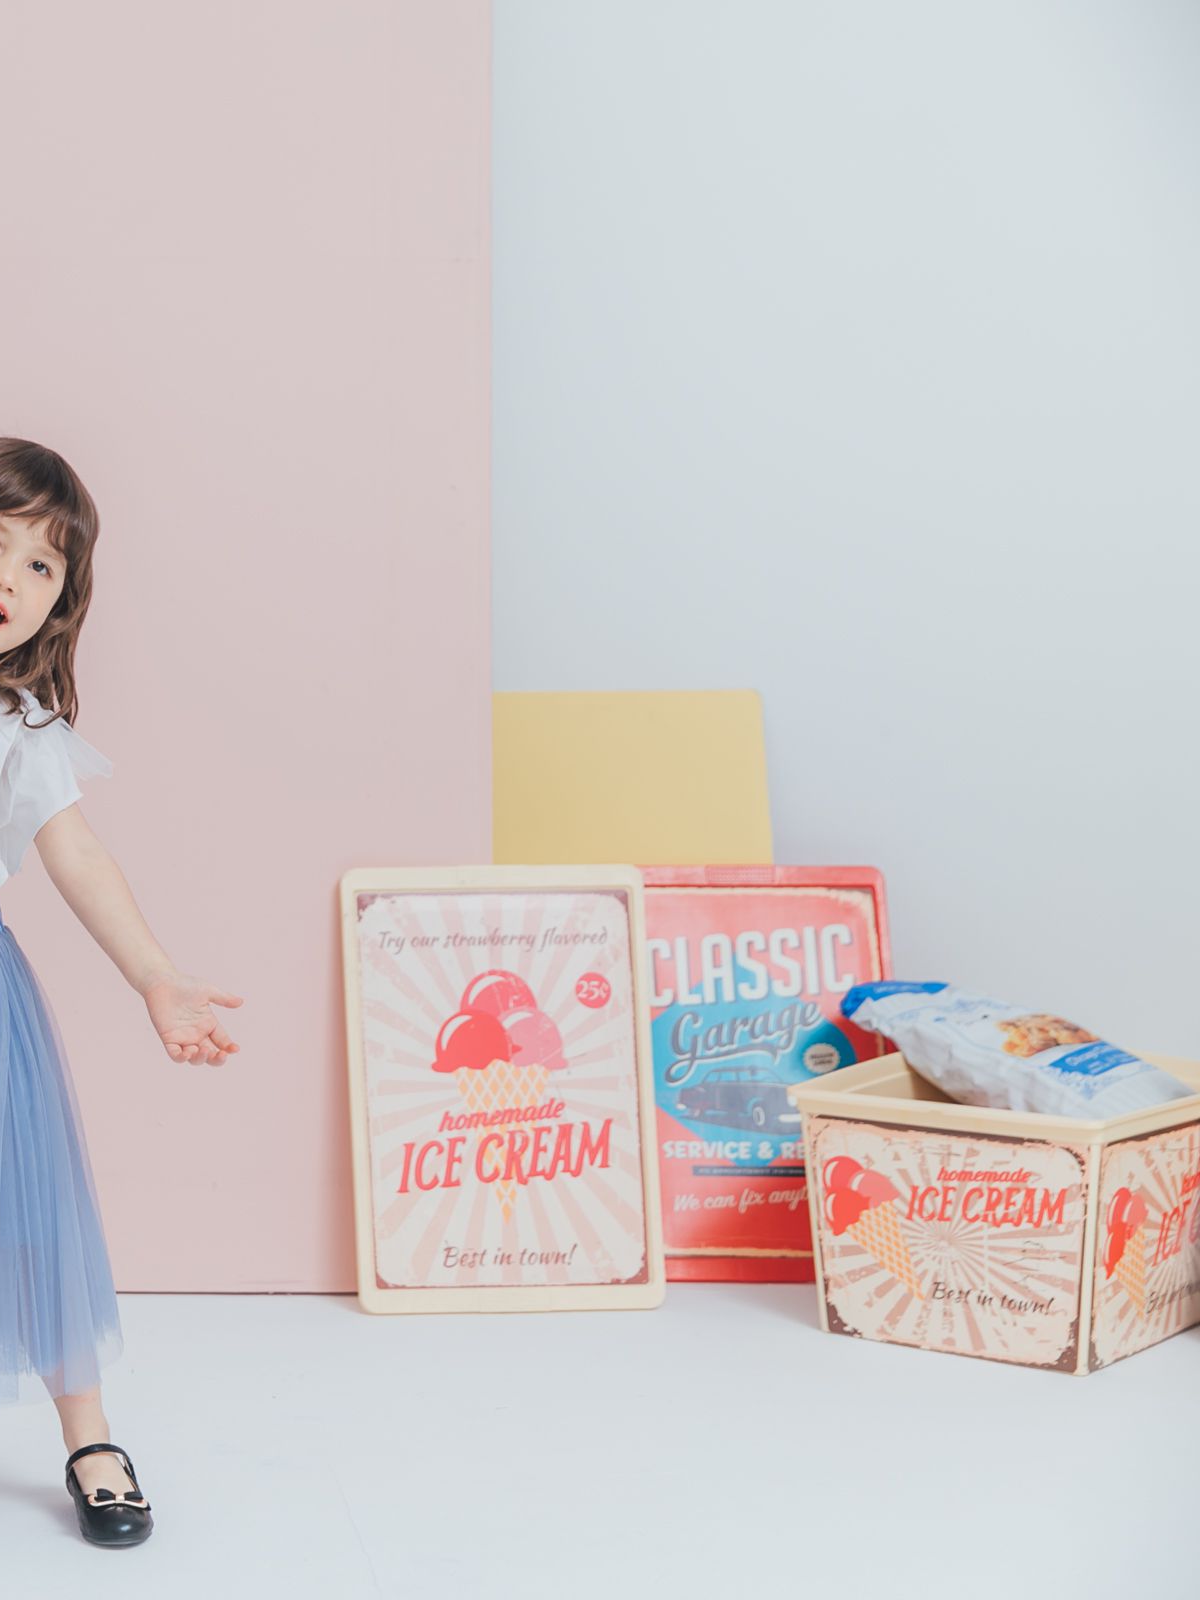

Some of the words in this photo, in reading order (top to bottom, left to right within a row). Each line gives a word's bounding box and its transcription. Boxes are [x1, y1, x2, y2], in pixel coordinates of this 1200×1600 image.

[378, 931, 406, 954] Try
[410, 937, 440, 948] our
[443, 928, 537, 952] strawberry
[538, 926, 609, 952] flavored
[646, 923, 856, 1008] CLASSIC
[664, 1002, 822, 1087] Garage
[438, 1098, 566, 1133] homemade
[397, 1136, 467, 1194] ICE
[475, 1118, 614, 1186] CREAM
[662, 1140, 752, 1159] SERVICE
[757, 1141, 774, 1159] &
[937, 1167, 1032, 1183] homemade
[673, 1194, 699, 1212] We
[704, 1195, 736, 1209] can
[738, 1188, 765, 1214] fix
[905, 1185, 957, 1222] ICE
[962, 1186, 1068, 1229] CREAM
[1152, 1199, 1191, 1267] ICE
[443, 1245, 488, 1268] Best
[493, 1249, 513, 1265] in
[518, 1243, 578, 1266] town!
[932, 1281, 972, 1304] Best
[977, 1290, 993, 1306] in
[999, 1295, 1055, 1315] town!
